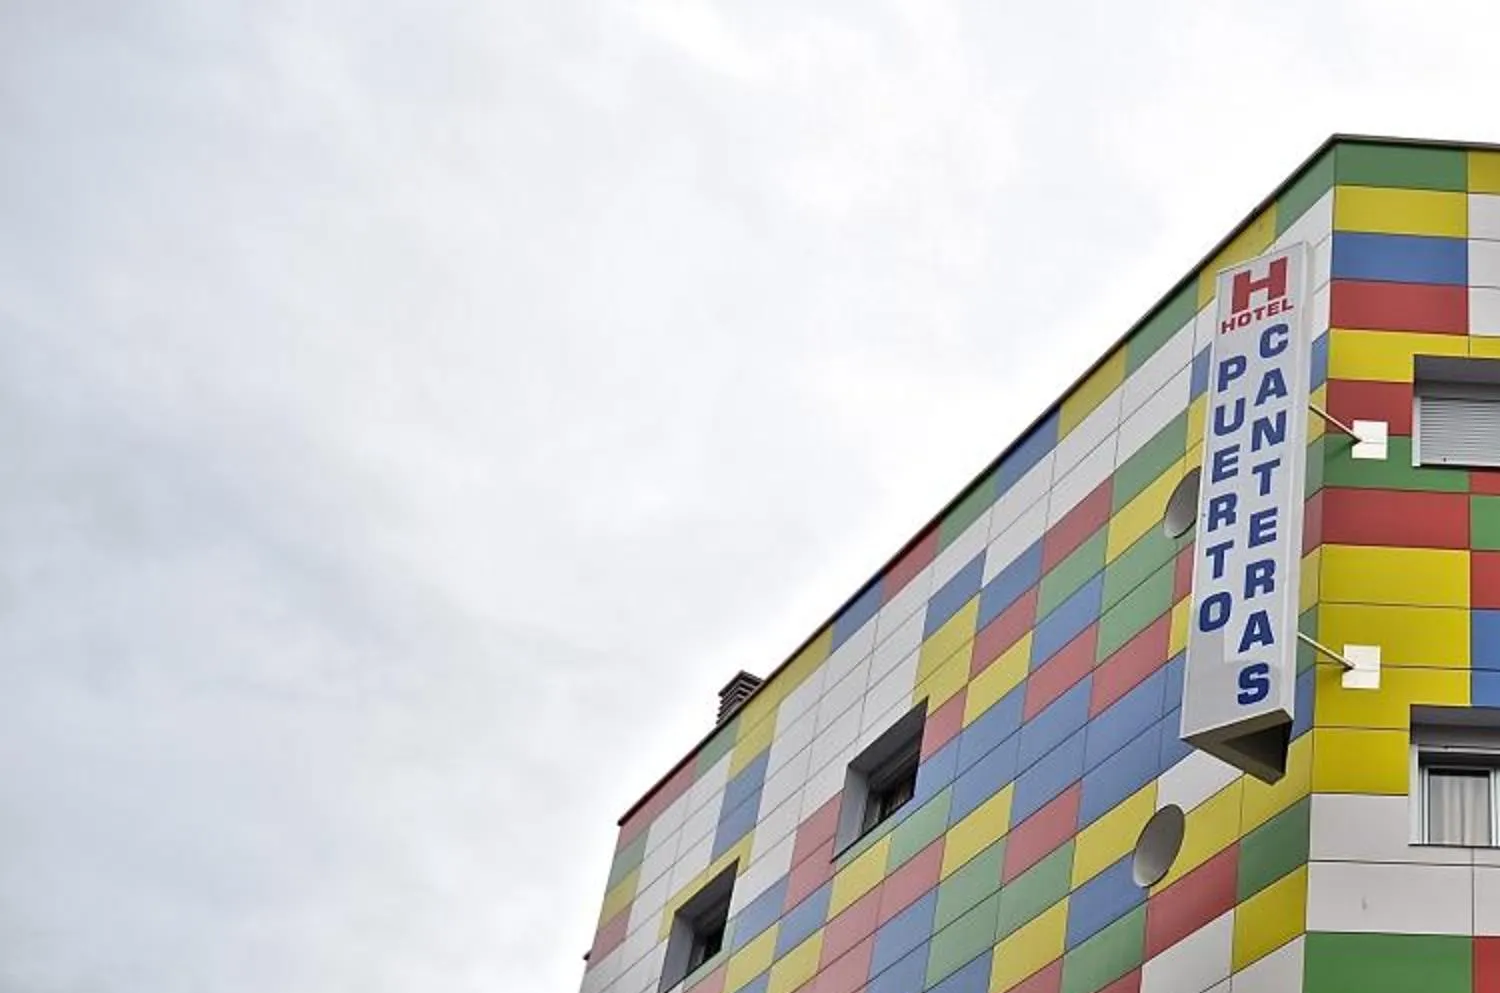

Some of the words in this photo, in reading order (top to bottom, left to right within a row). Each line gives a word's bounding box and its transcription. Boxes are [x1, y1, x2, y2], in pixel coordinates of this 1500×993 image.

[1221, 298, 1294, 334] HOTEL
[1231, 256, 1288, 314] H
[1199, 354, 1247, 633] PUERTO
[1237, 323, 1289, 705] CANTERAS
